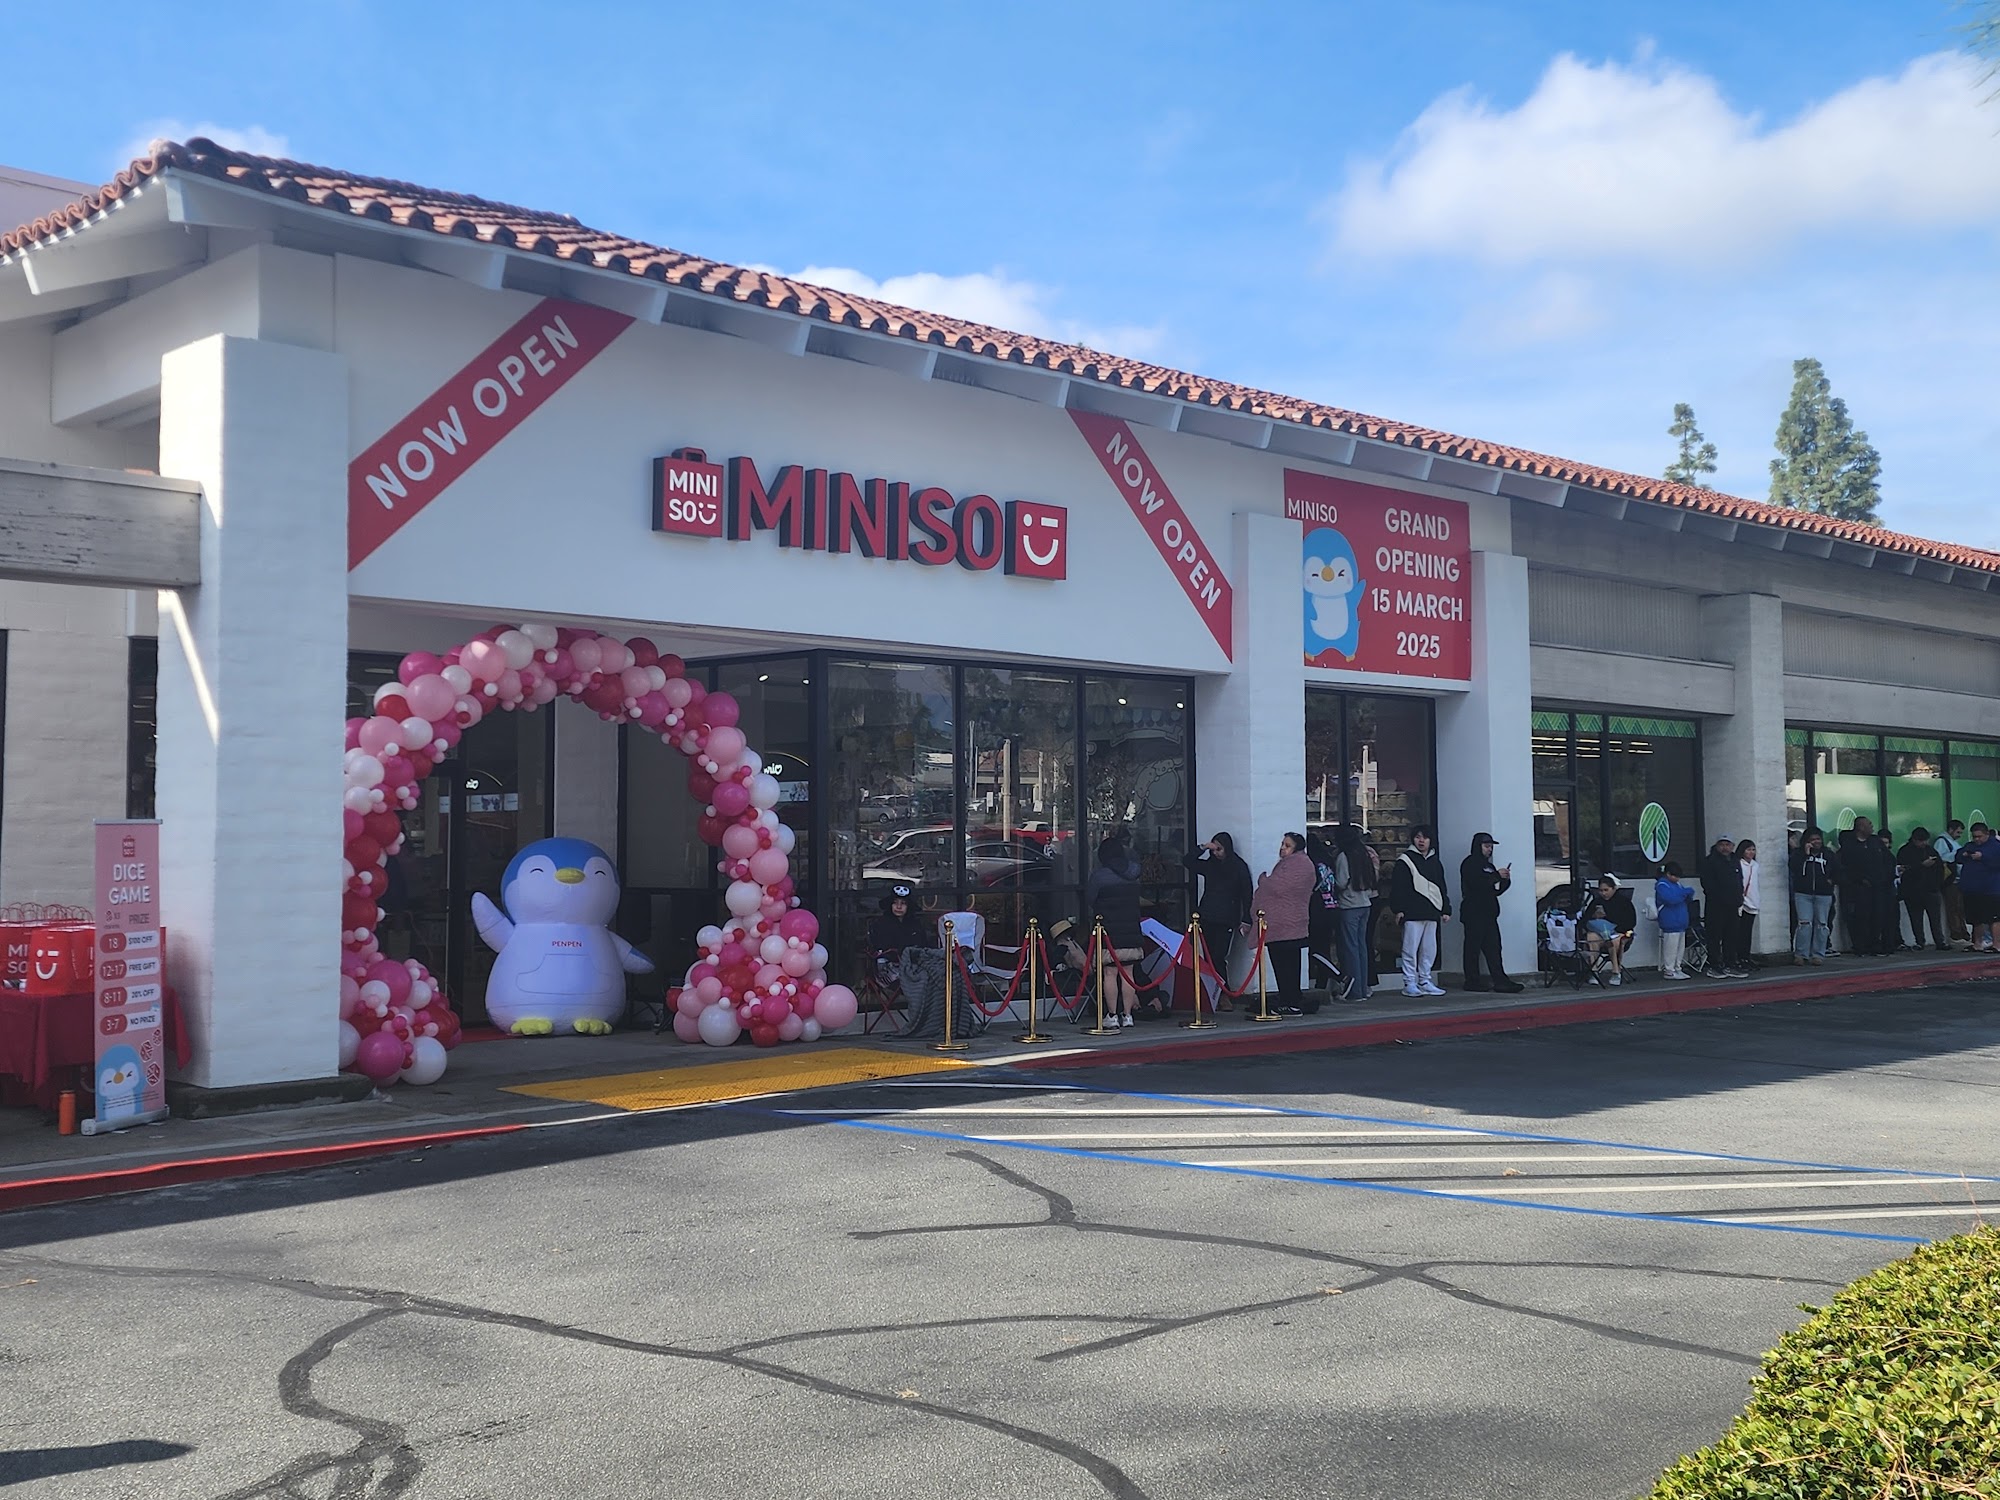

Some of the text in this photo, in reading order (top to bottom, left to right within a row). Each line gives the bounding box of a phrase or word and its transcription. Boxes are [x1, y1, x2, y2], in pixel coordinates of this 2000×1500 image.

[365, 314, 579, 510] NOW OPEN
[669, 468, 717, 497] MINI
[728, 455, 1004, 571] MINISO
[1105, 432, 1222, 610] NOW OPEN
[1287, 497, 1338, 524] MINISO
[1384, 507, 1450, 541] GRAND
[1375, 546, 1460, 582] OPENING
[1371, 587, 1463, 622] 15 MARCH
[1396, 631, 1441, 659] 2025
[113, 863, 146, 881] DICE
[108, 885, 151, 904] GAME
[128, 913, 150, 924] PRIZE
[108, 937, 119, 949] 18
[141, 935, 153, 943] OFF
[102, 961, 156, 977] 12-17 FREE GIFT
[103, 991, 121, 1004] 8-11
[142, 988, 155, 997] OFF
[106, 1015, 156, 1031] 3-7 NO PRIZE
